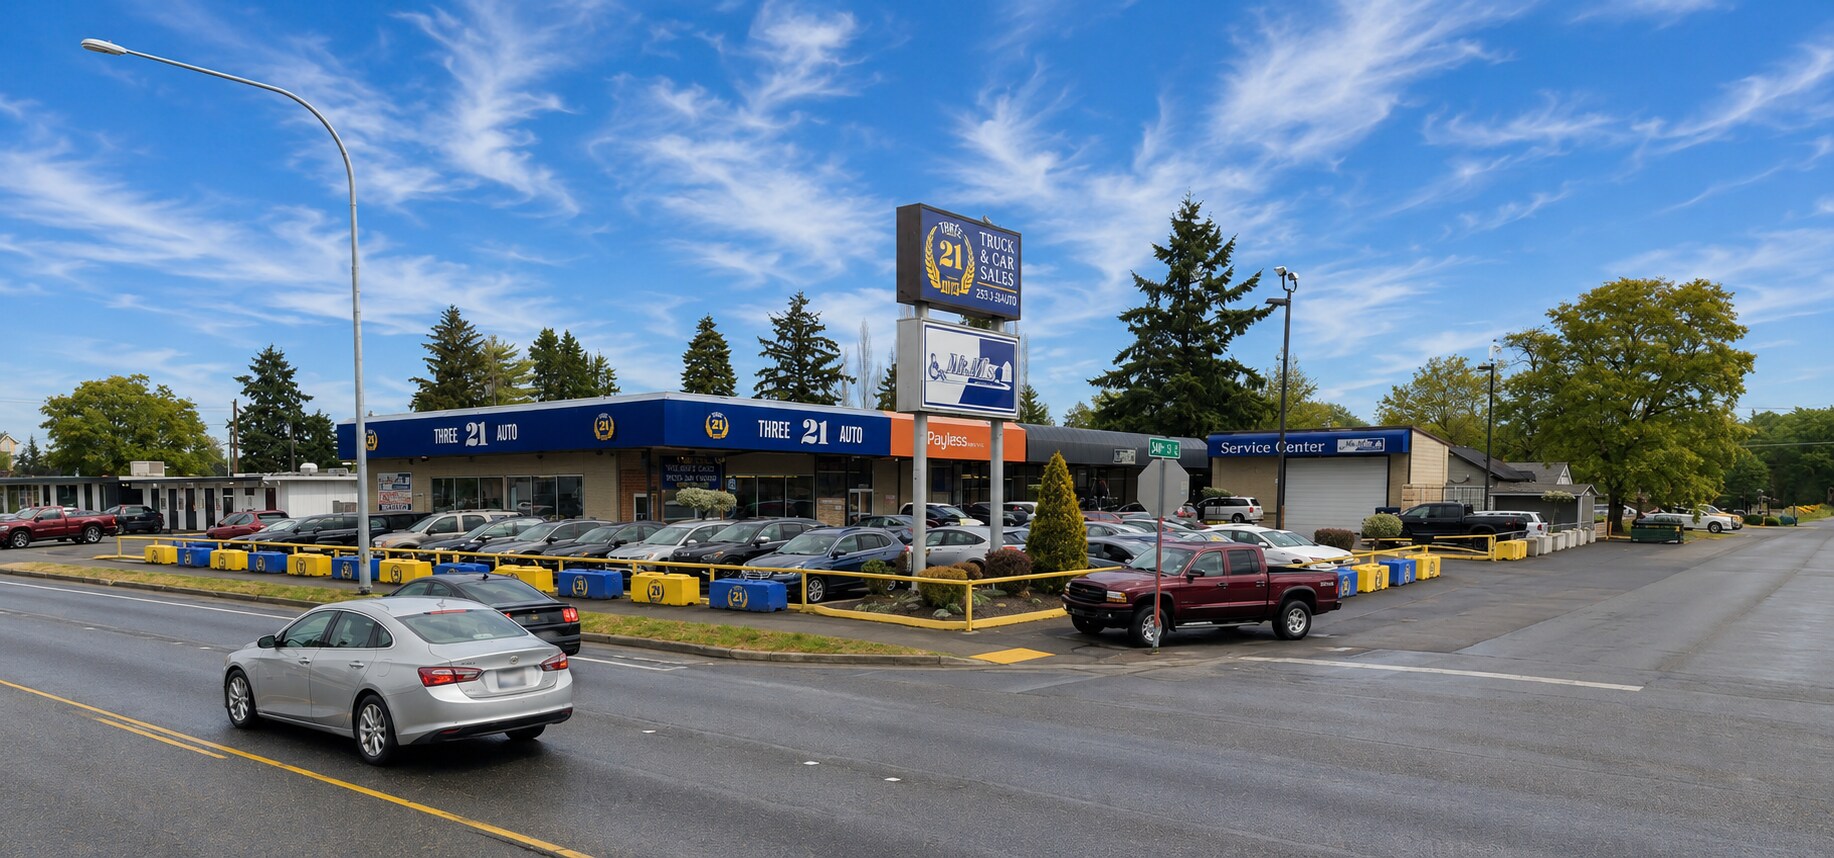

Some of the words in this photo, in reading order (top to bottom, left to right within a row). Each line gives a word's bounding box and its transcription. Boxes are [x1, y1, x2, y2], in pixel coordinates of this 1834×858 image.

[979, 231, 1015, 254] TRUCK
[939, 240, 963, 270] 21
[980, 249, 989, 264] &
[992, 252, 1015, 270] CAR
[980, 265, 1014, 287] SALES
[433, 427, 458, 444] THREE
[465, 421, 488, 447] 21
[496, 423, 518, 441] AUTO
[758, 419, 791, 439] THREE
[800, 418, 829, 445] 21
[839, 425, 863, 444] AUTO
[927, 431, 968, 450] Payless
[1220, 441, 1271, 454] Service
[1275, 441, 1326, 453] Center
[732, 591, 743, 603] 21
